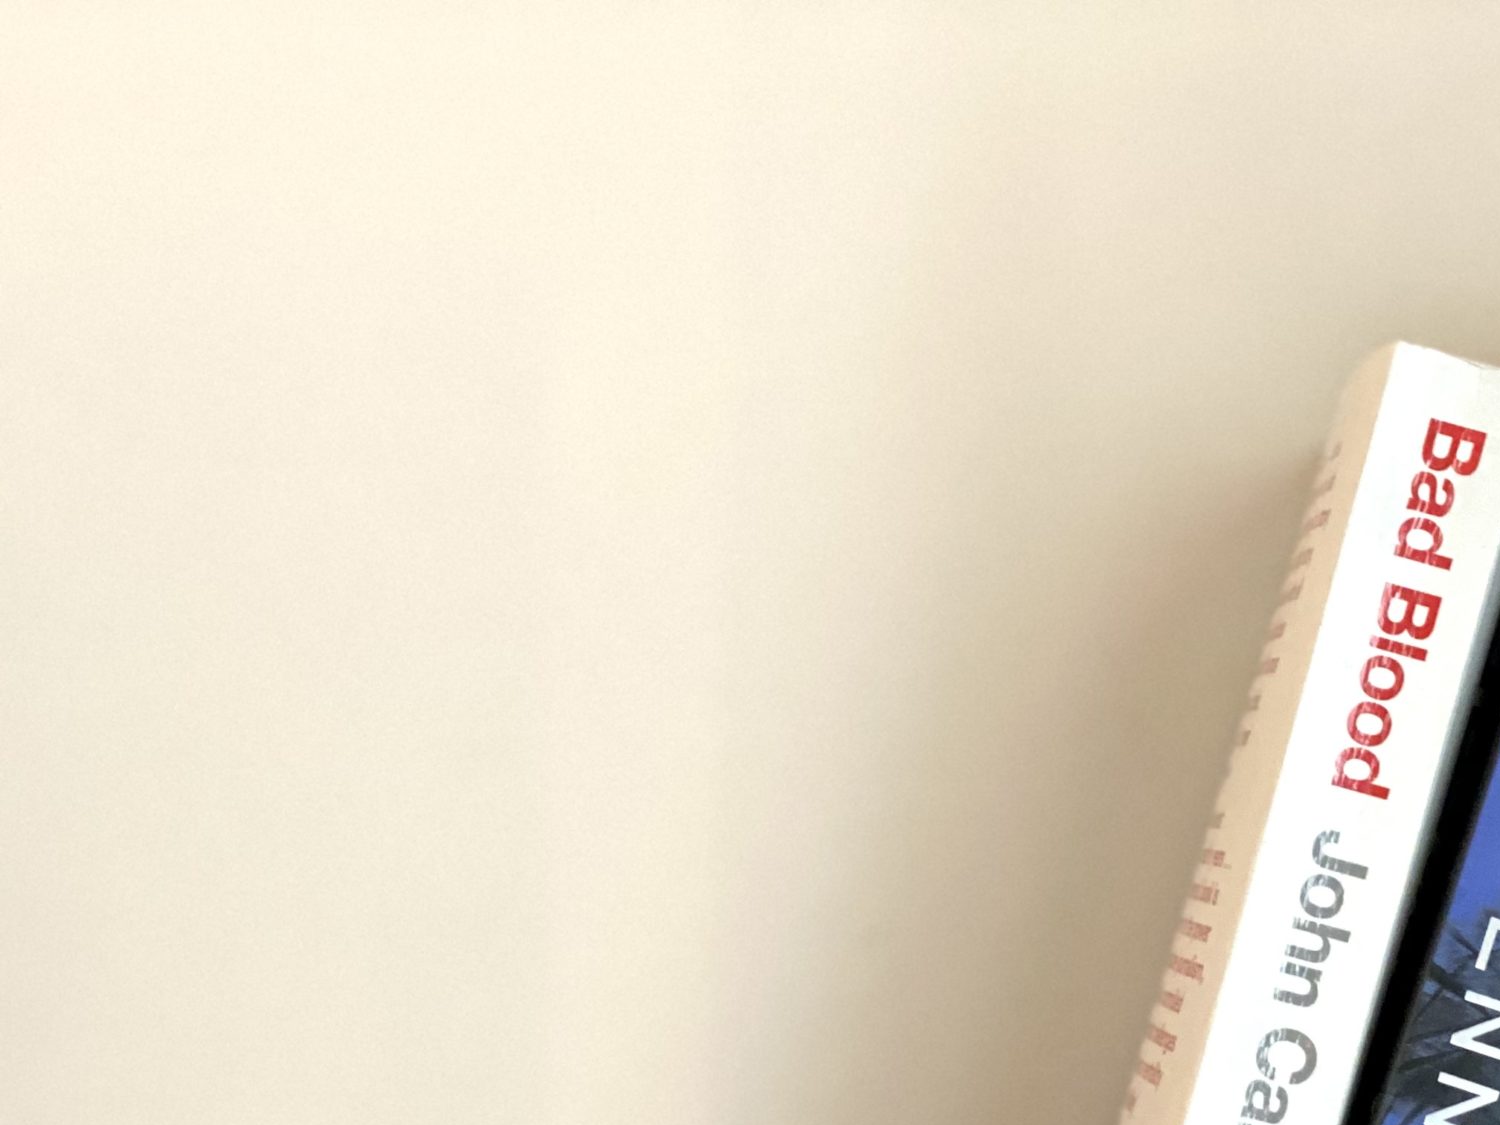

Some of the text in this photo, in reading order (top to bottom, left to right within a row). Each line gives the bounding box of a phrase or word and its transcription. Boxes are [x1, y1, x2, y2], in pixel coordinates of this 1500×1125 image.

[1394, 418, 1487, 571] Bad
[1331, 582, 1442, 800] Blood
[1273, 830, 1369, 1009] John
